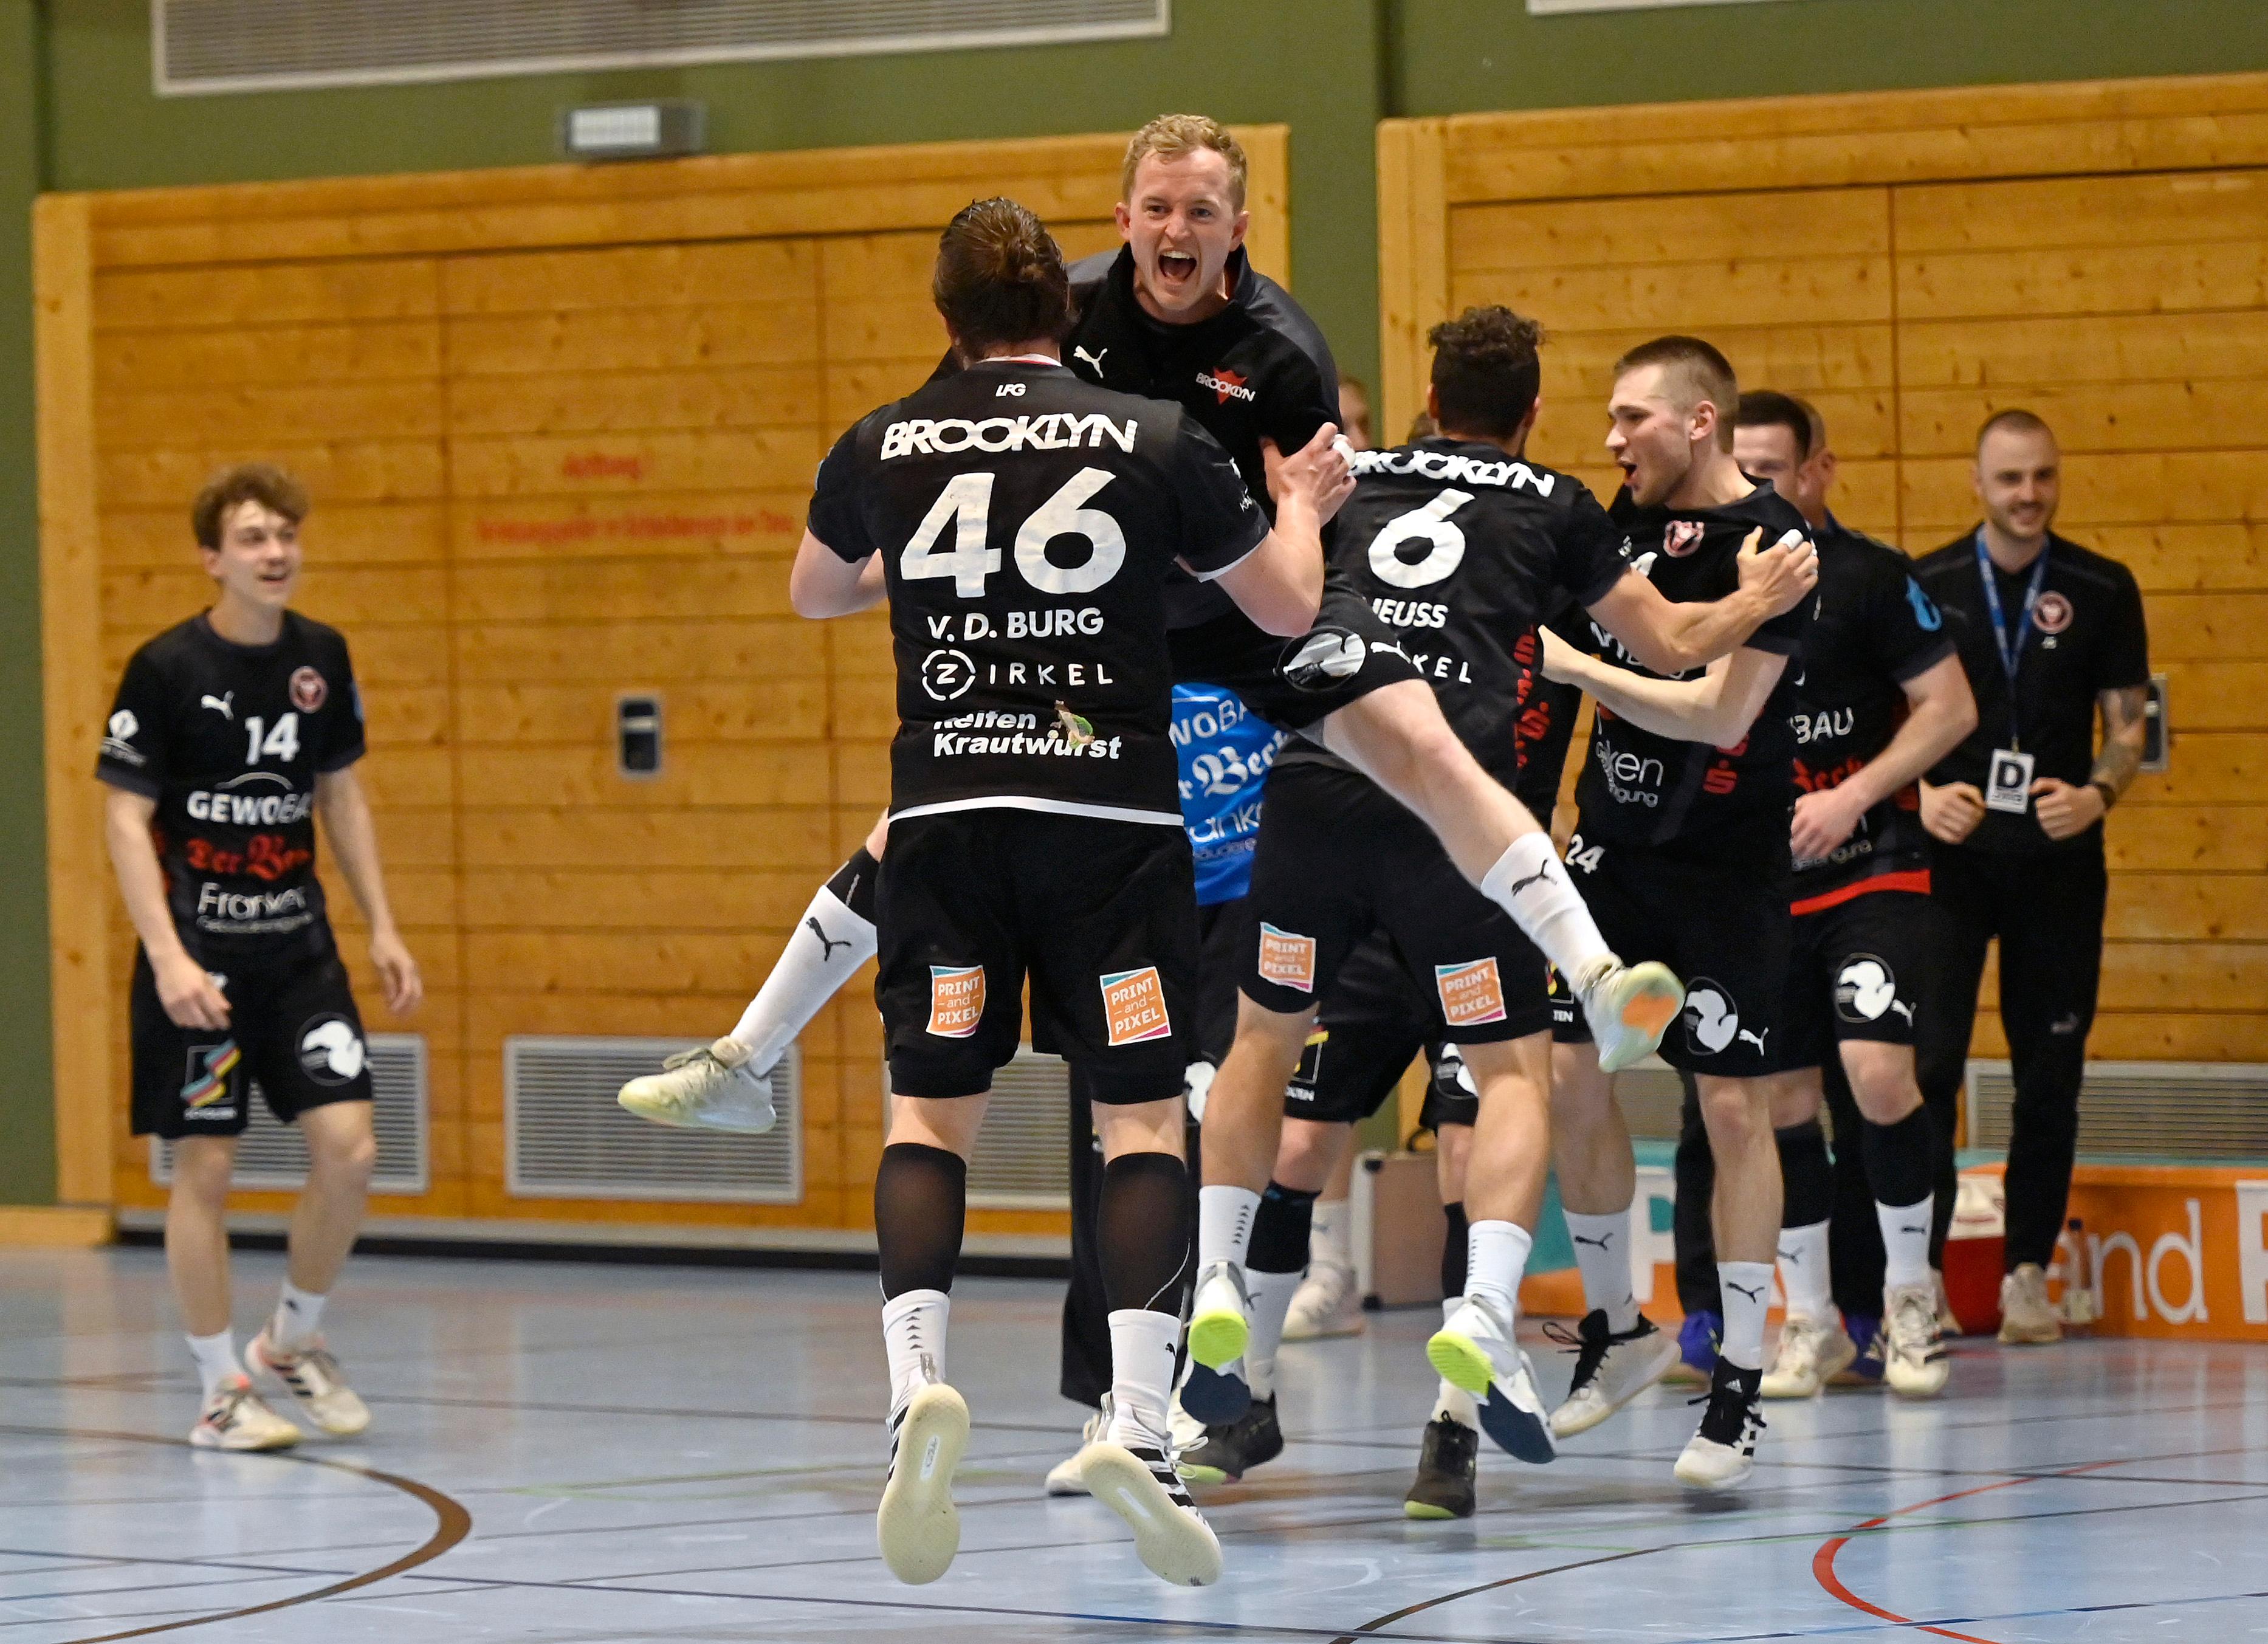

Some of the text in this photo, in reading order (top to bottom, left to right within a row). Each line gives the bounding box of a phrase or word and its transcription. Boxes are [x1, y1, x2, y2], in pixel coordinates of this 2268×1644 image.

[995, 383, 1026, 397] LFG
[1195, 372, 1256, 402] BROOKLYN
[881, 413, 1138, 461] BROOKLYN
[900, 466, 1126, 598] 46
[1368, 488, 1476, 589] 6
[927, 607, 1104, 642] V. D. BURG
[244, 712, 301, 766] 14
[933, 732, 1122, 760] Krautwurst
[1996, 759, 2026, 788] D
[1565, 833, 1606, 875] 24
[1265, 938, 1307, 954] PRINT
[1264, 961, 1307, 976] PIXEL
[1446, 967, 1490, 994] PRINT
[938, 975, 980, 997] PRINT
[1111, 977, 1153, 1006] PRINT
[947, 993, 971, 1008] and
[1124, 995, 1148, 1014] and
[1449, 994, 1496, 1018] PIXEL
[937, 1006, 979, 1025] PIXEL
[1115, 1008, 1161, 1034] PIXEL
